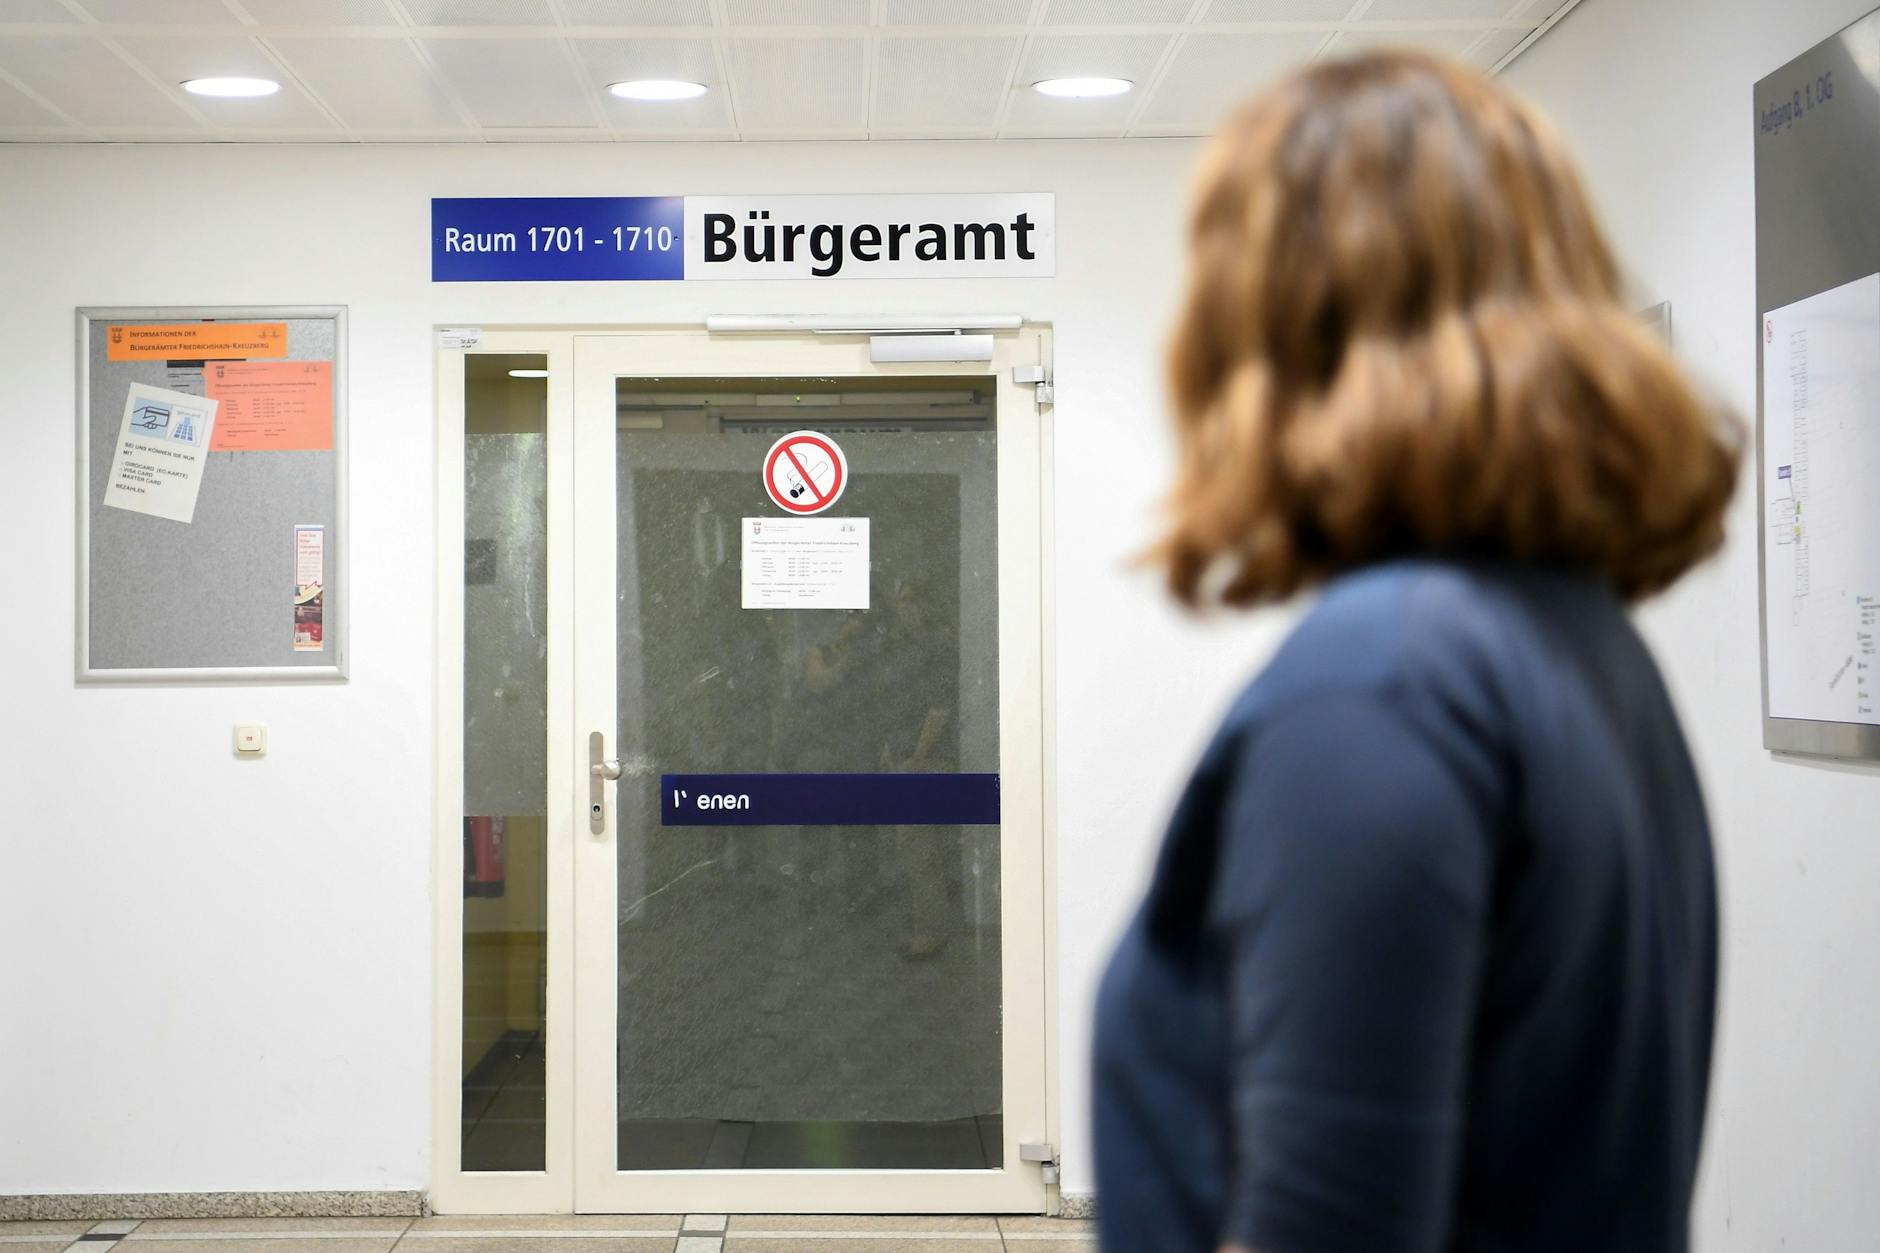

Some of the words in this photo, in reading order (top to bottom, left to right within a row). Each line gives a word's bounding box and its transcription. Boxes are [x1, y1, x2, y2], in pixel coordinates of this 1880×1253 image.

[445, 227, 516, 252] Raum
[527, 226, 584, 252] 1701
[612, 225, 672, 252] 1710
[703, 210, 1035, 278] Bürgeramt
[697, 794, 750, 810] enen
